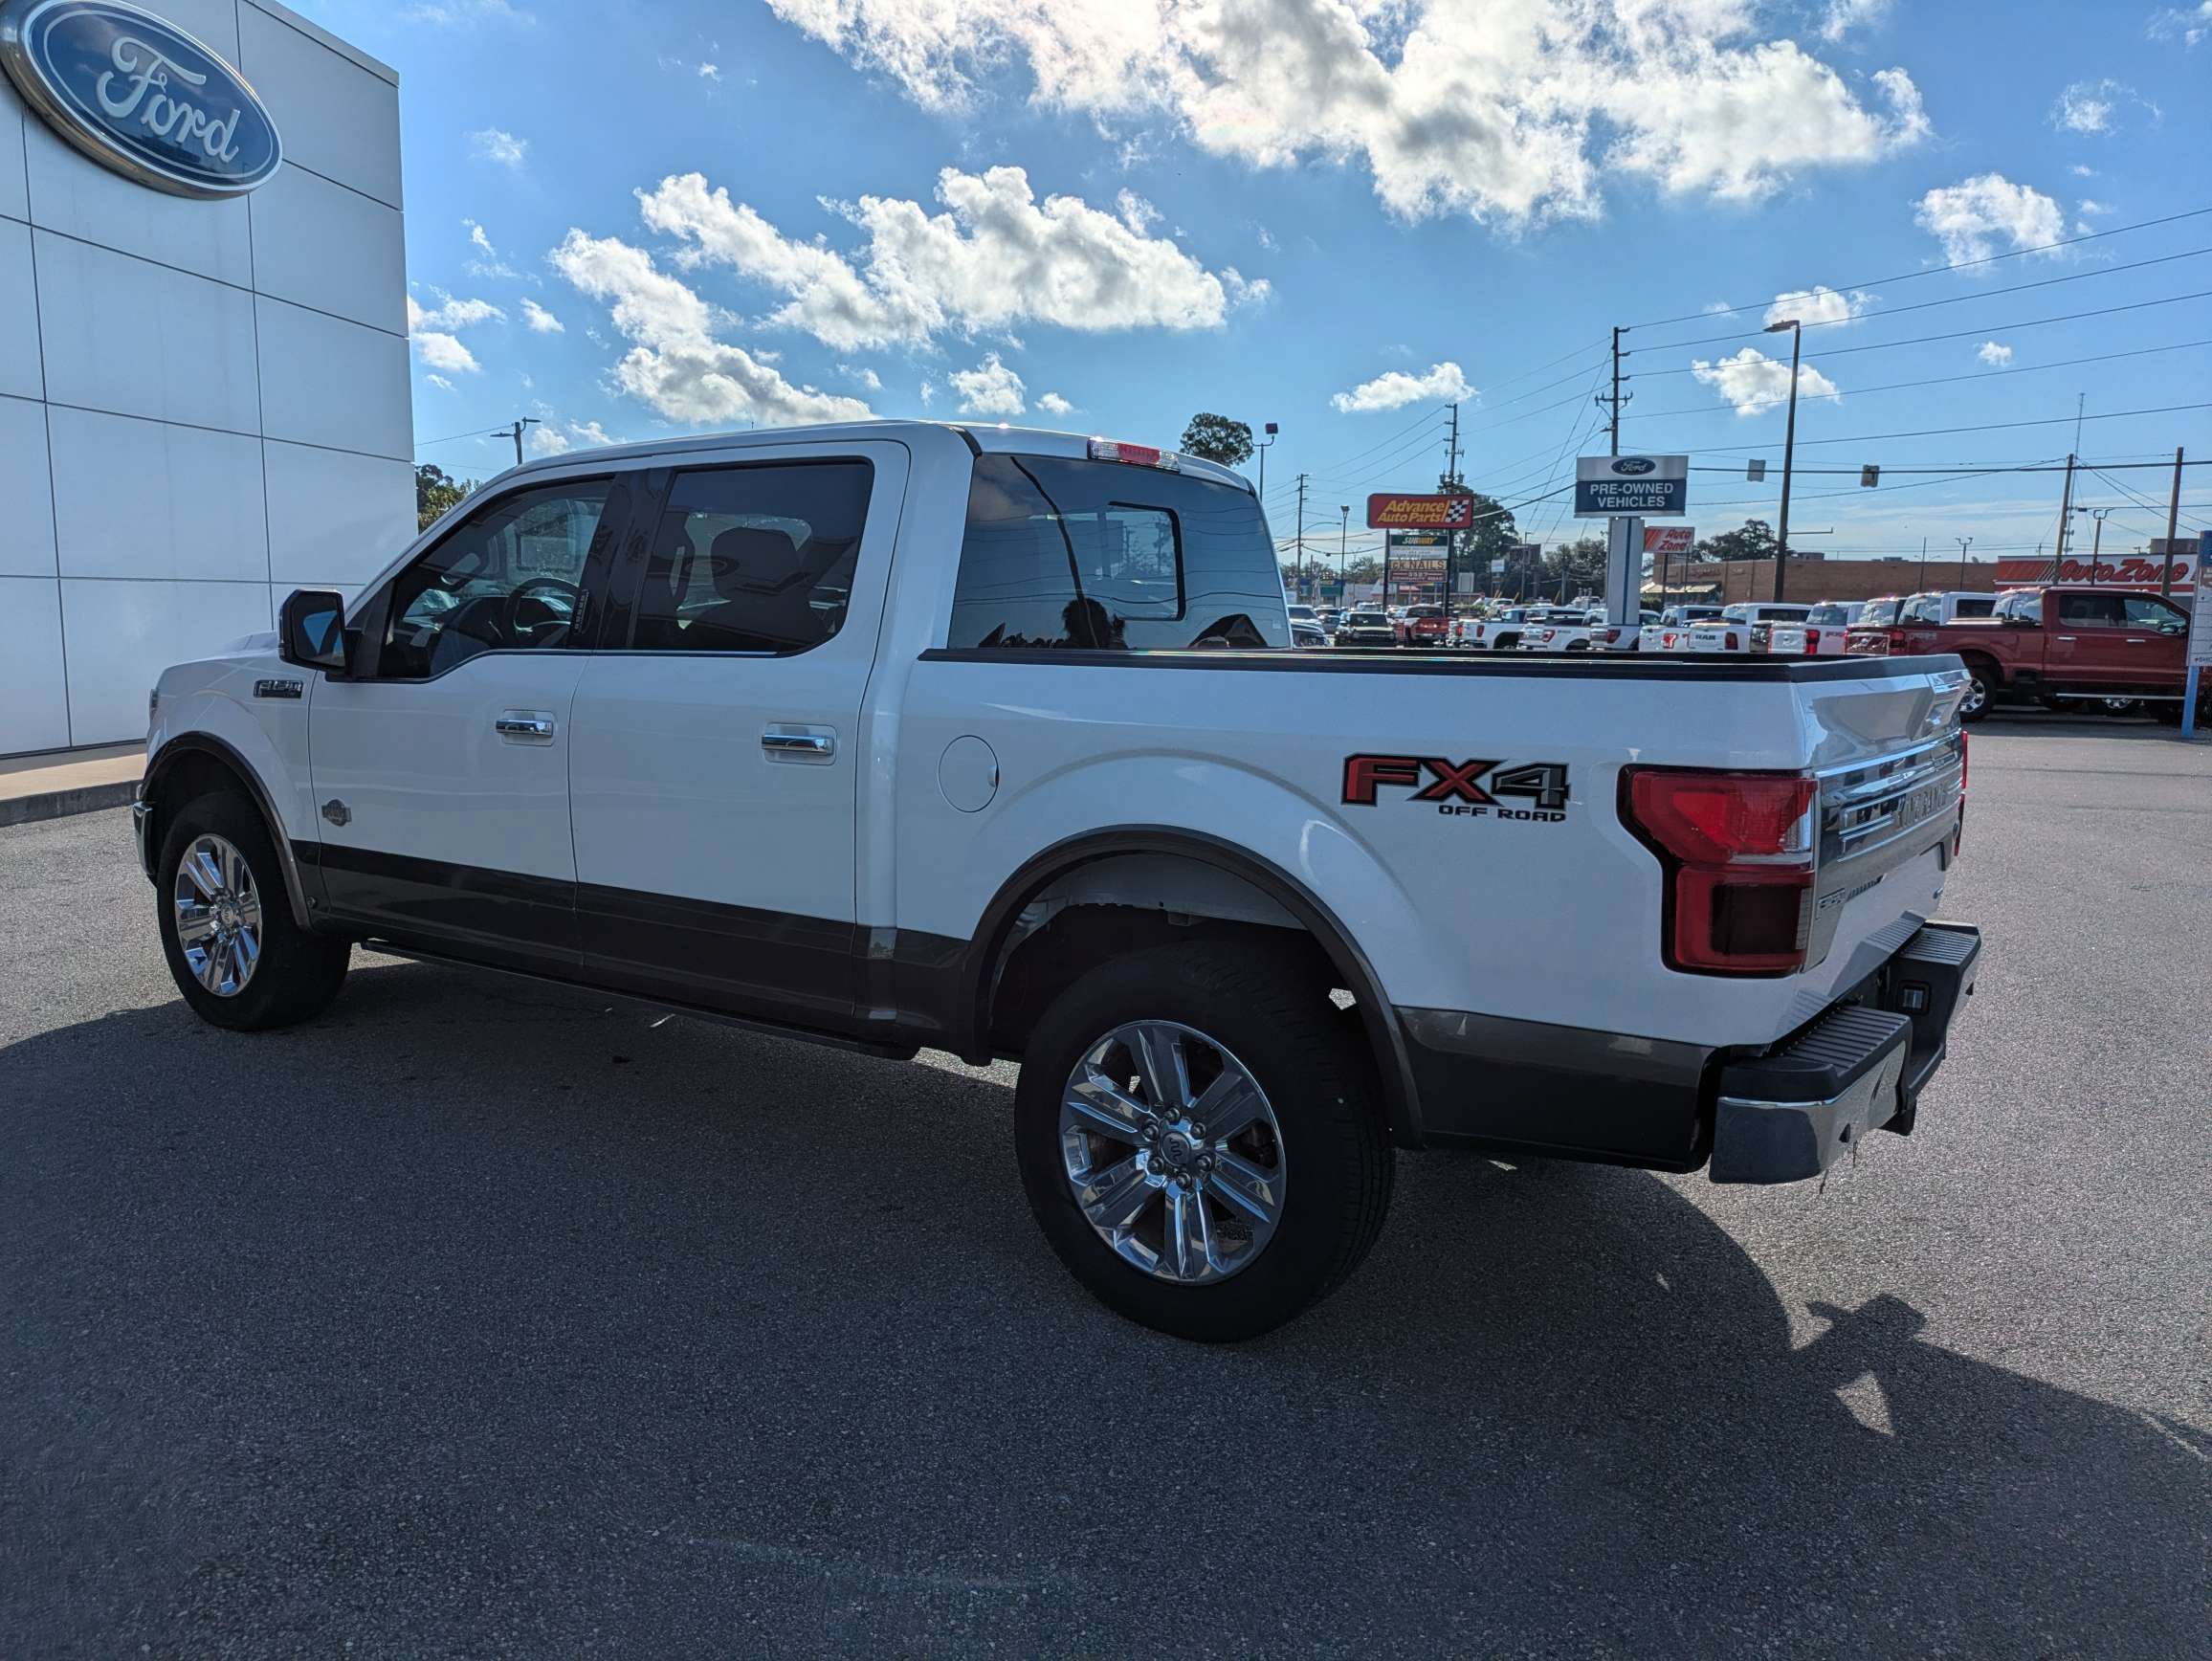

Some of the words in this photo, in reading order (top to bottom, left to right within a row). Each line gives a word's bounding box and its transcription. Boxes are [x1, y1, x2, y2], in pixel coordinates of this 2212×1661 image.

[97, 35, 240, 163] Ford
[1620, 461, 1648, 472] Ford
[1589, 482, 1674, 495] PRE-OWNED
[1383, 499, 1445, 512] Advance
[1597, 496, 1666, 508] VEHICLES
[1378, 512, 1407, 522] Auto
[1407, 512, 1440, 522] Parts
[1665, 529, 1692, 540] Auto
[1658, 540, 1689, 551] Zone
[1408, 560, 1445, 570] NAILS
[1341, 754, 1571, 812] FX4
[1439, 805, 1487, 816] OFF
[1497, 808, 1558, 823] ROAD
